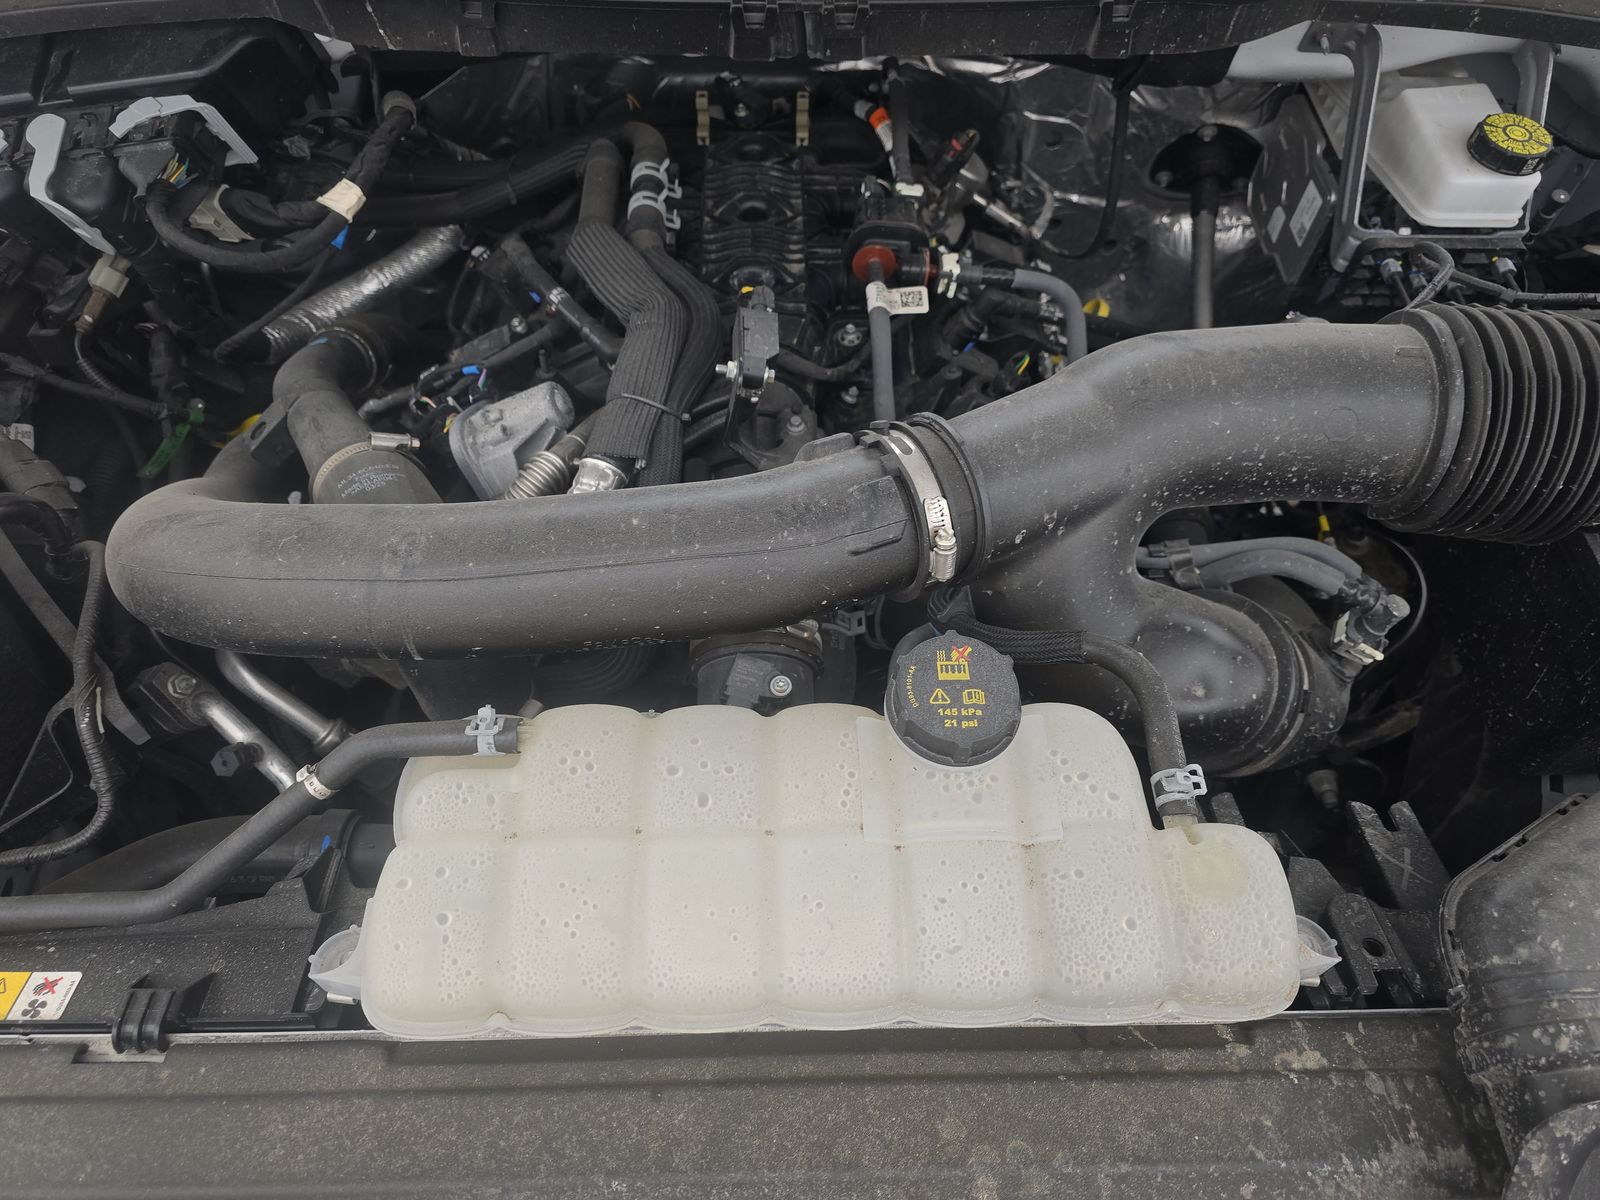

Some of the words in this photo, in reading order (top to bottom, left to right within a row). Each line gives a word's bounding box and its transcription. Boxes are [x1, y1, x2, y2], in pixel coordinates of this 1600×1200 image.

[961, 708, 982, 716] kPa
[944, 719, 958, 727] 21
[961, 719, 978, 728] psi
